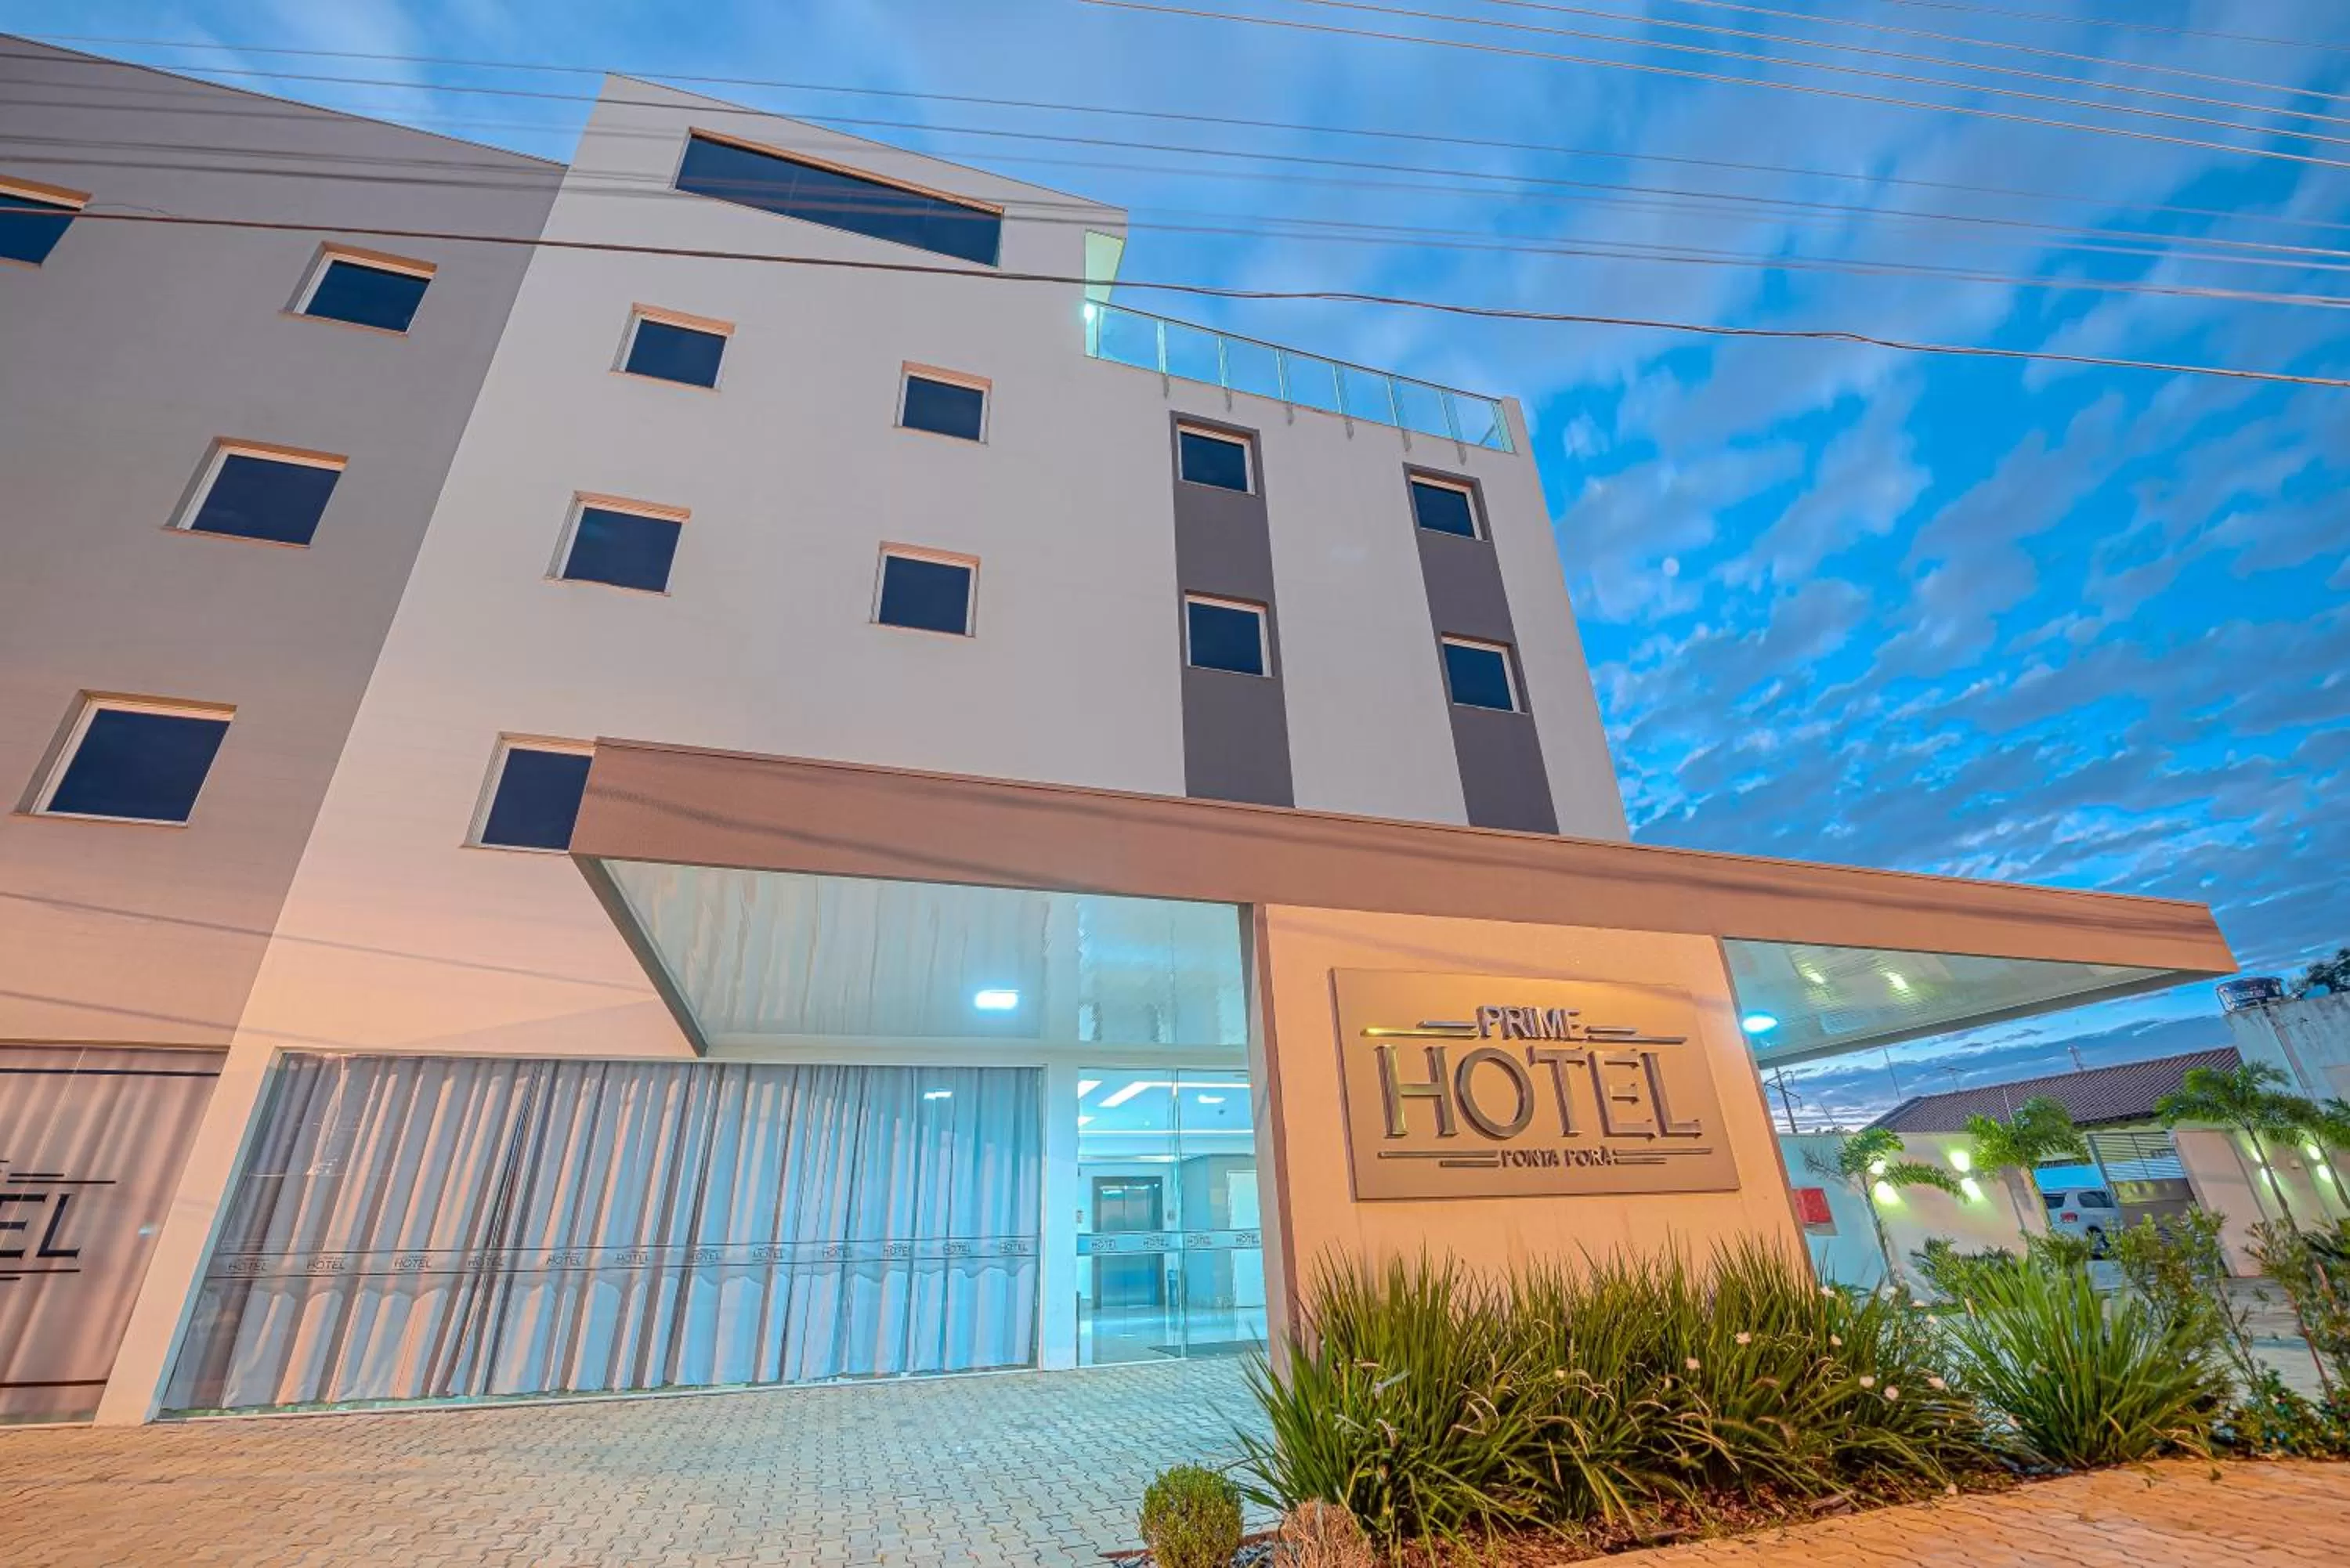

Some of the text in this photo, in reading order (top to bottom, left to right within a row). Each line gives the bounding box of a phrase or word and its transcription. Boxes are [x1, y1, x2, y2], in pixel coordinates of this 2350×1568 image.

[1476, 1005, 1585, 1040] PRIME
[1374, 1044, 1703, 1140] HOTEL
[1500, 1148, 1560, 1168] PONTA
[394, 1259, 432, 1268] HOTEL
